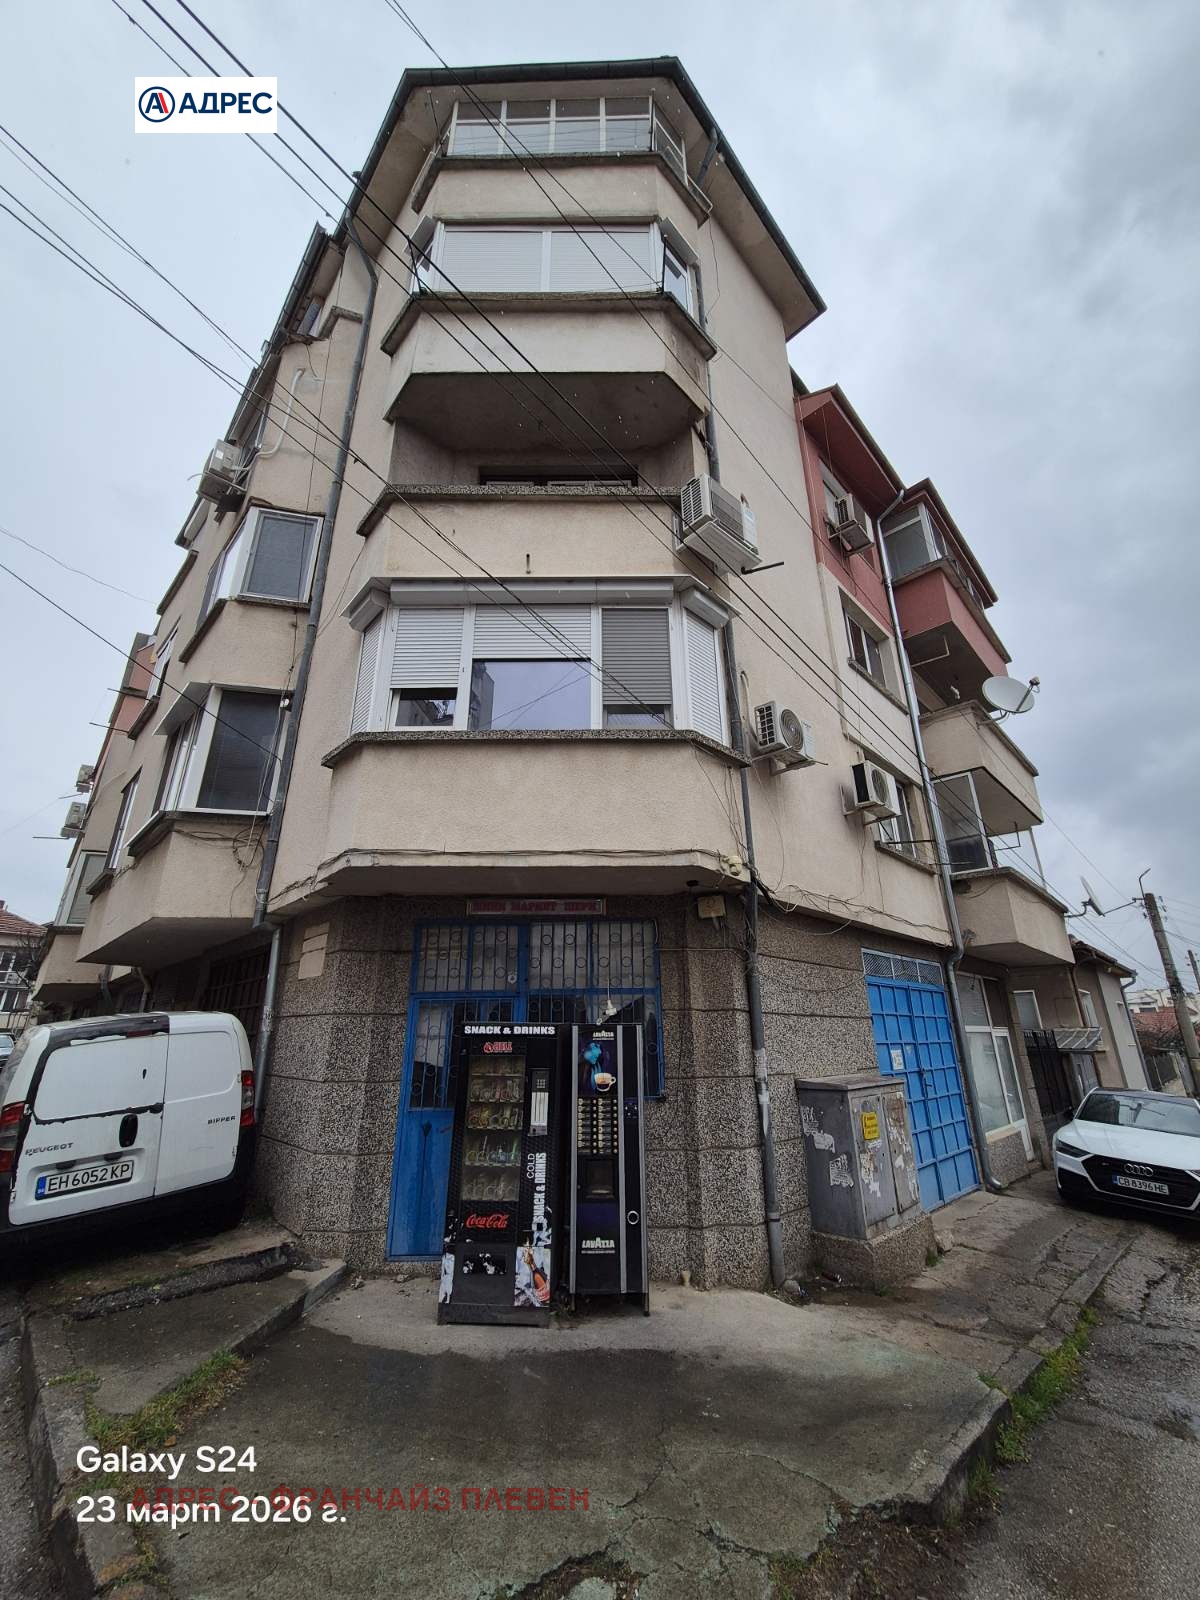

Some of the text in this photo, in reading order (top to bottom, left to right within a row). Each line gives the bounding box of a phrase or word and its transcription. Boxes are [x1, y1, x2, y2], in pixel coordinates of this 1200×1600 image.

[464, 1025, 556, 1035] SNACK & DRINKS
[207, 1116, 236, 1124] BIPPER
[25, 1143, 74, 1156] PEUGEOT
[526, 1153, 535, 1179] COLD
[534, 1152, 546, 1183] DRINKS
[533, 1192, 546, 1223] SNACK
[581, 1237, 615, 1248] LAVAZZA
